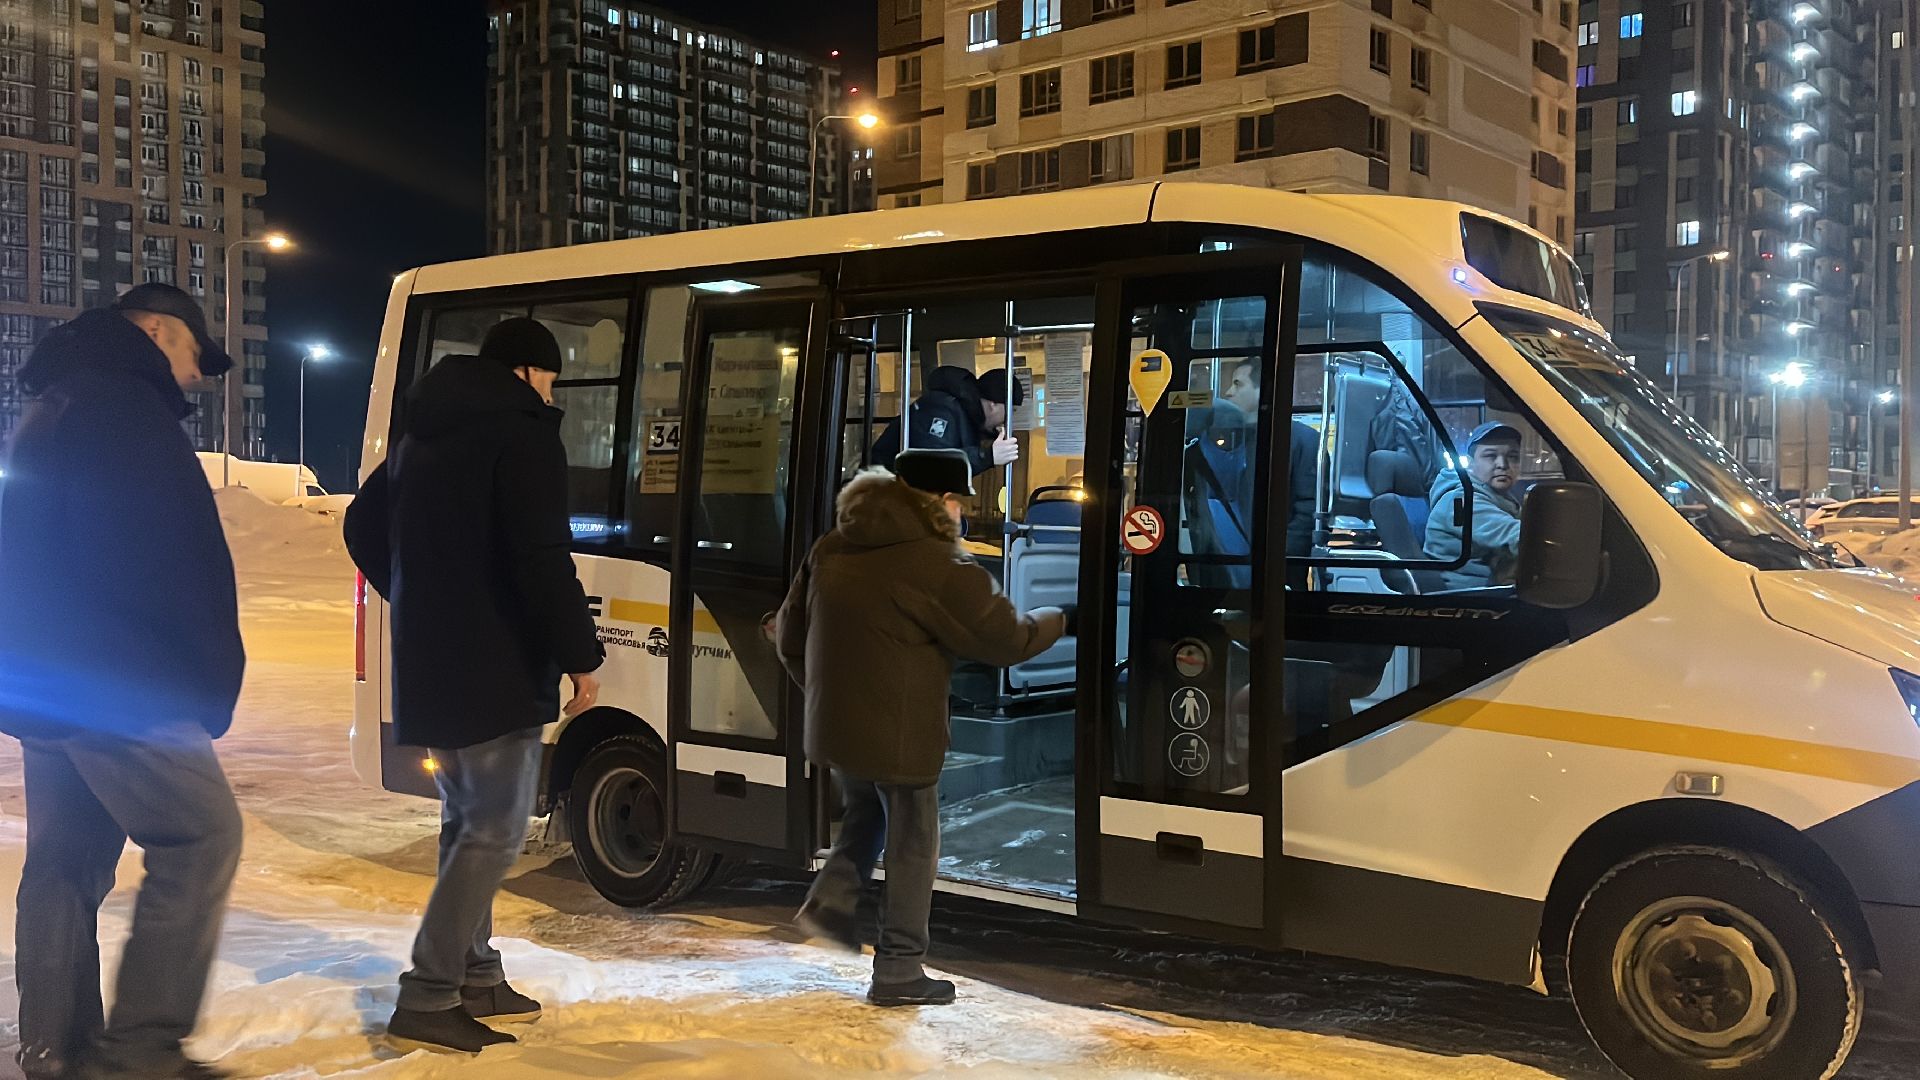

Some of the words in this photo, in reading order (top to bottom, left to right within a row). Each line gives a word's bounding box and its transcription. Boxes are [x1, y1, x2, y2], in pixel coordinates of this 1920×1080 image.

[653, 425, 680, 448] 34
[597, 625, 634, 638] РАНСПОРТ
[596, 634, 646, 650] ОДМОСКОВЬЯ
